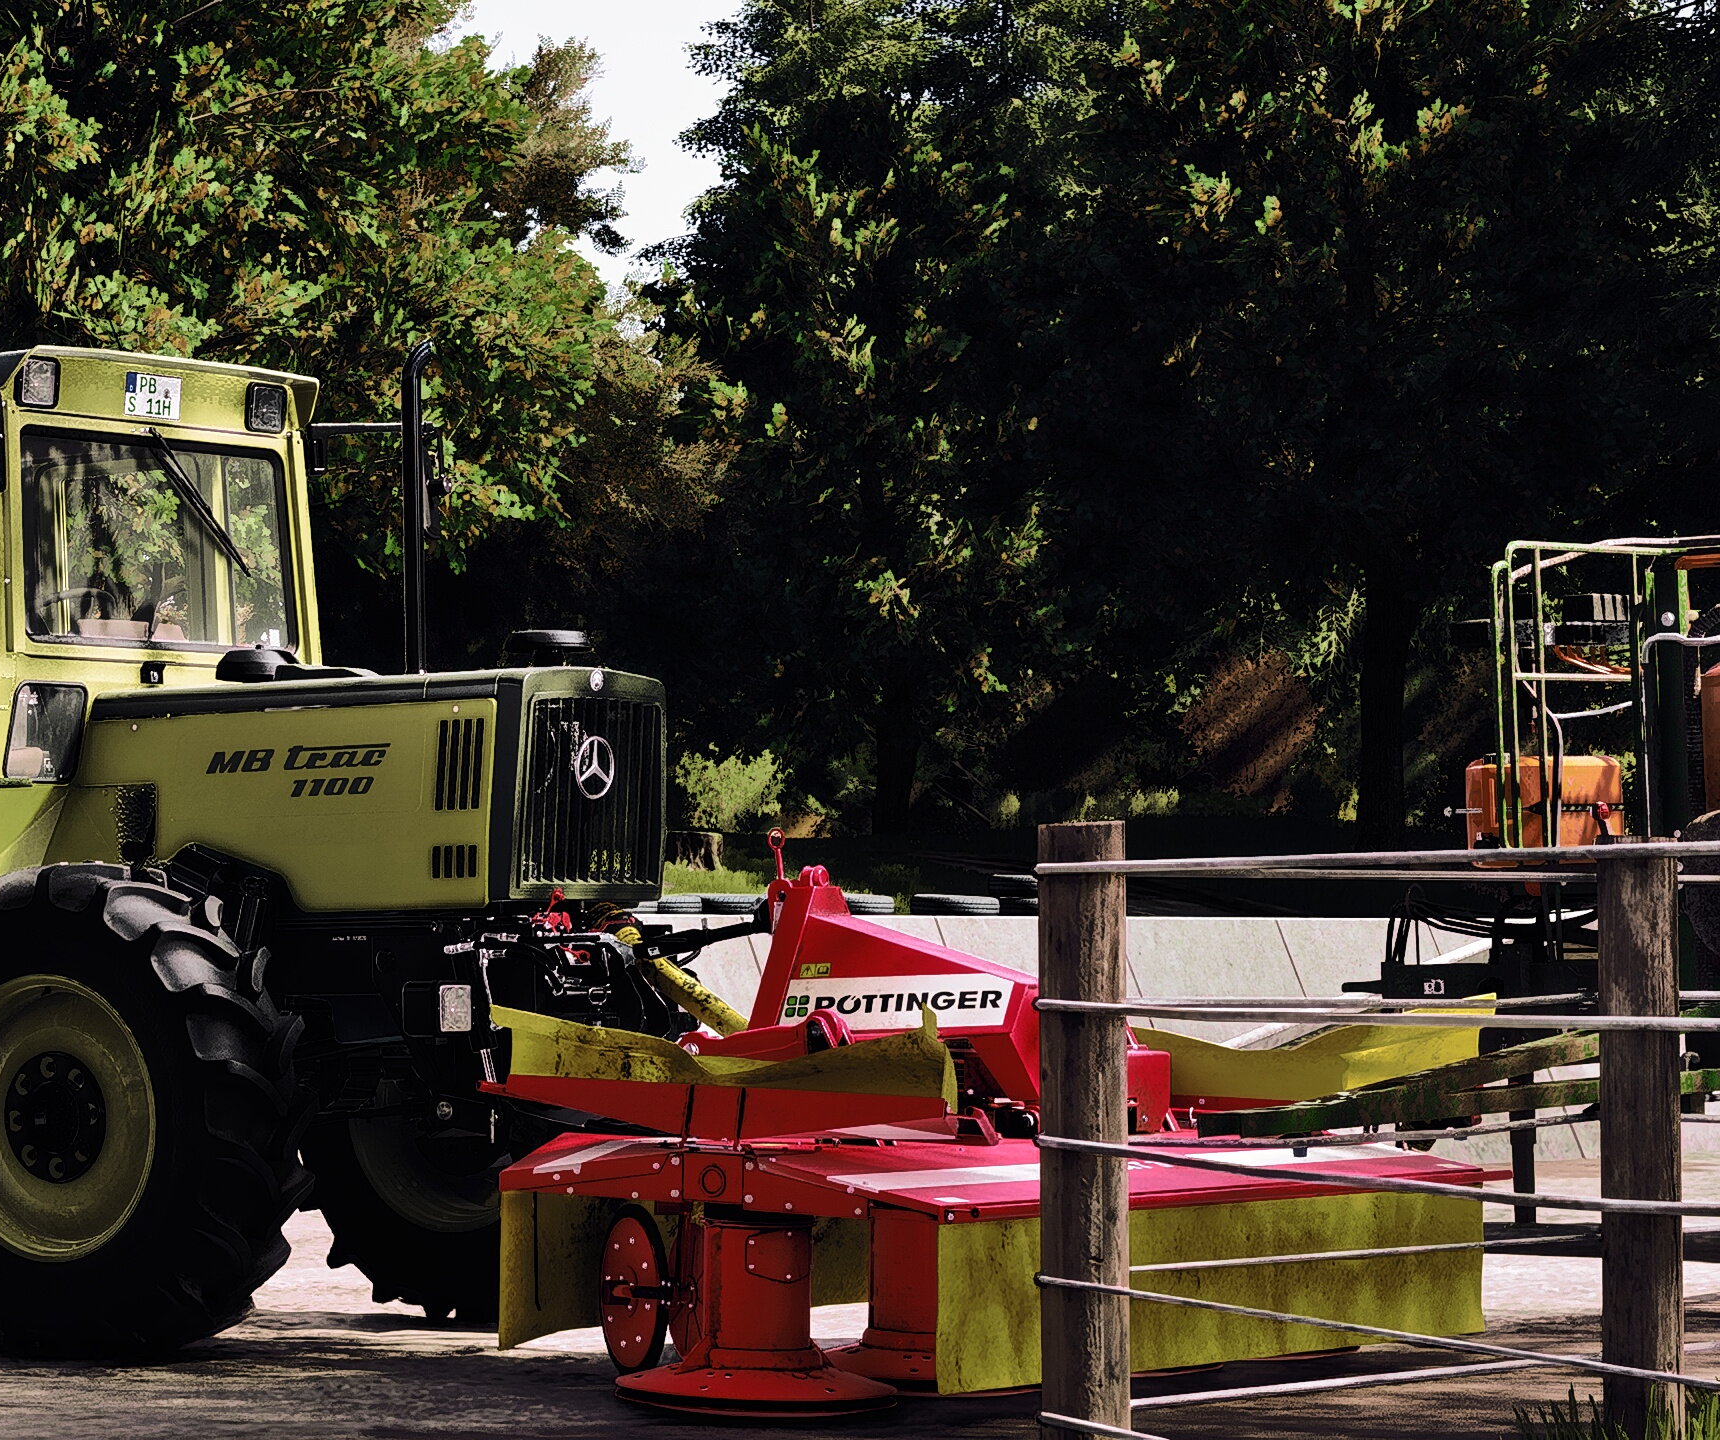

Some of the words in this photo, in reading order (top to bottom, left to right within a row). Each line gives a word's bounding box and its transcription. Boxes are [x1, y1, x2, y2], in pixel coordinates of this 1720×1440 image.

[139, 376, 157, 394] PB
[127, 396, 137, 413] S
[145, 398, 171, 416] 11H
[205, 749, 275, 775] MB
[283, 743, 391, 771] trac
[290, 776, 375, 798] 1100
[814, 990, 1003, 1015] PÖTTINGER
